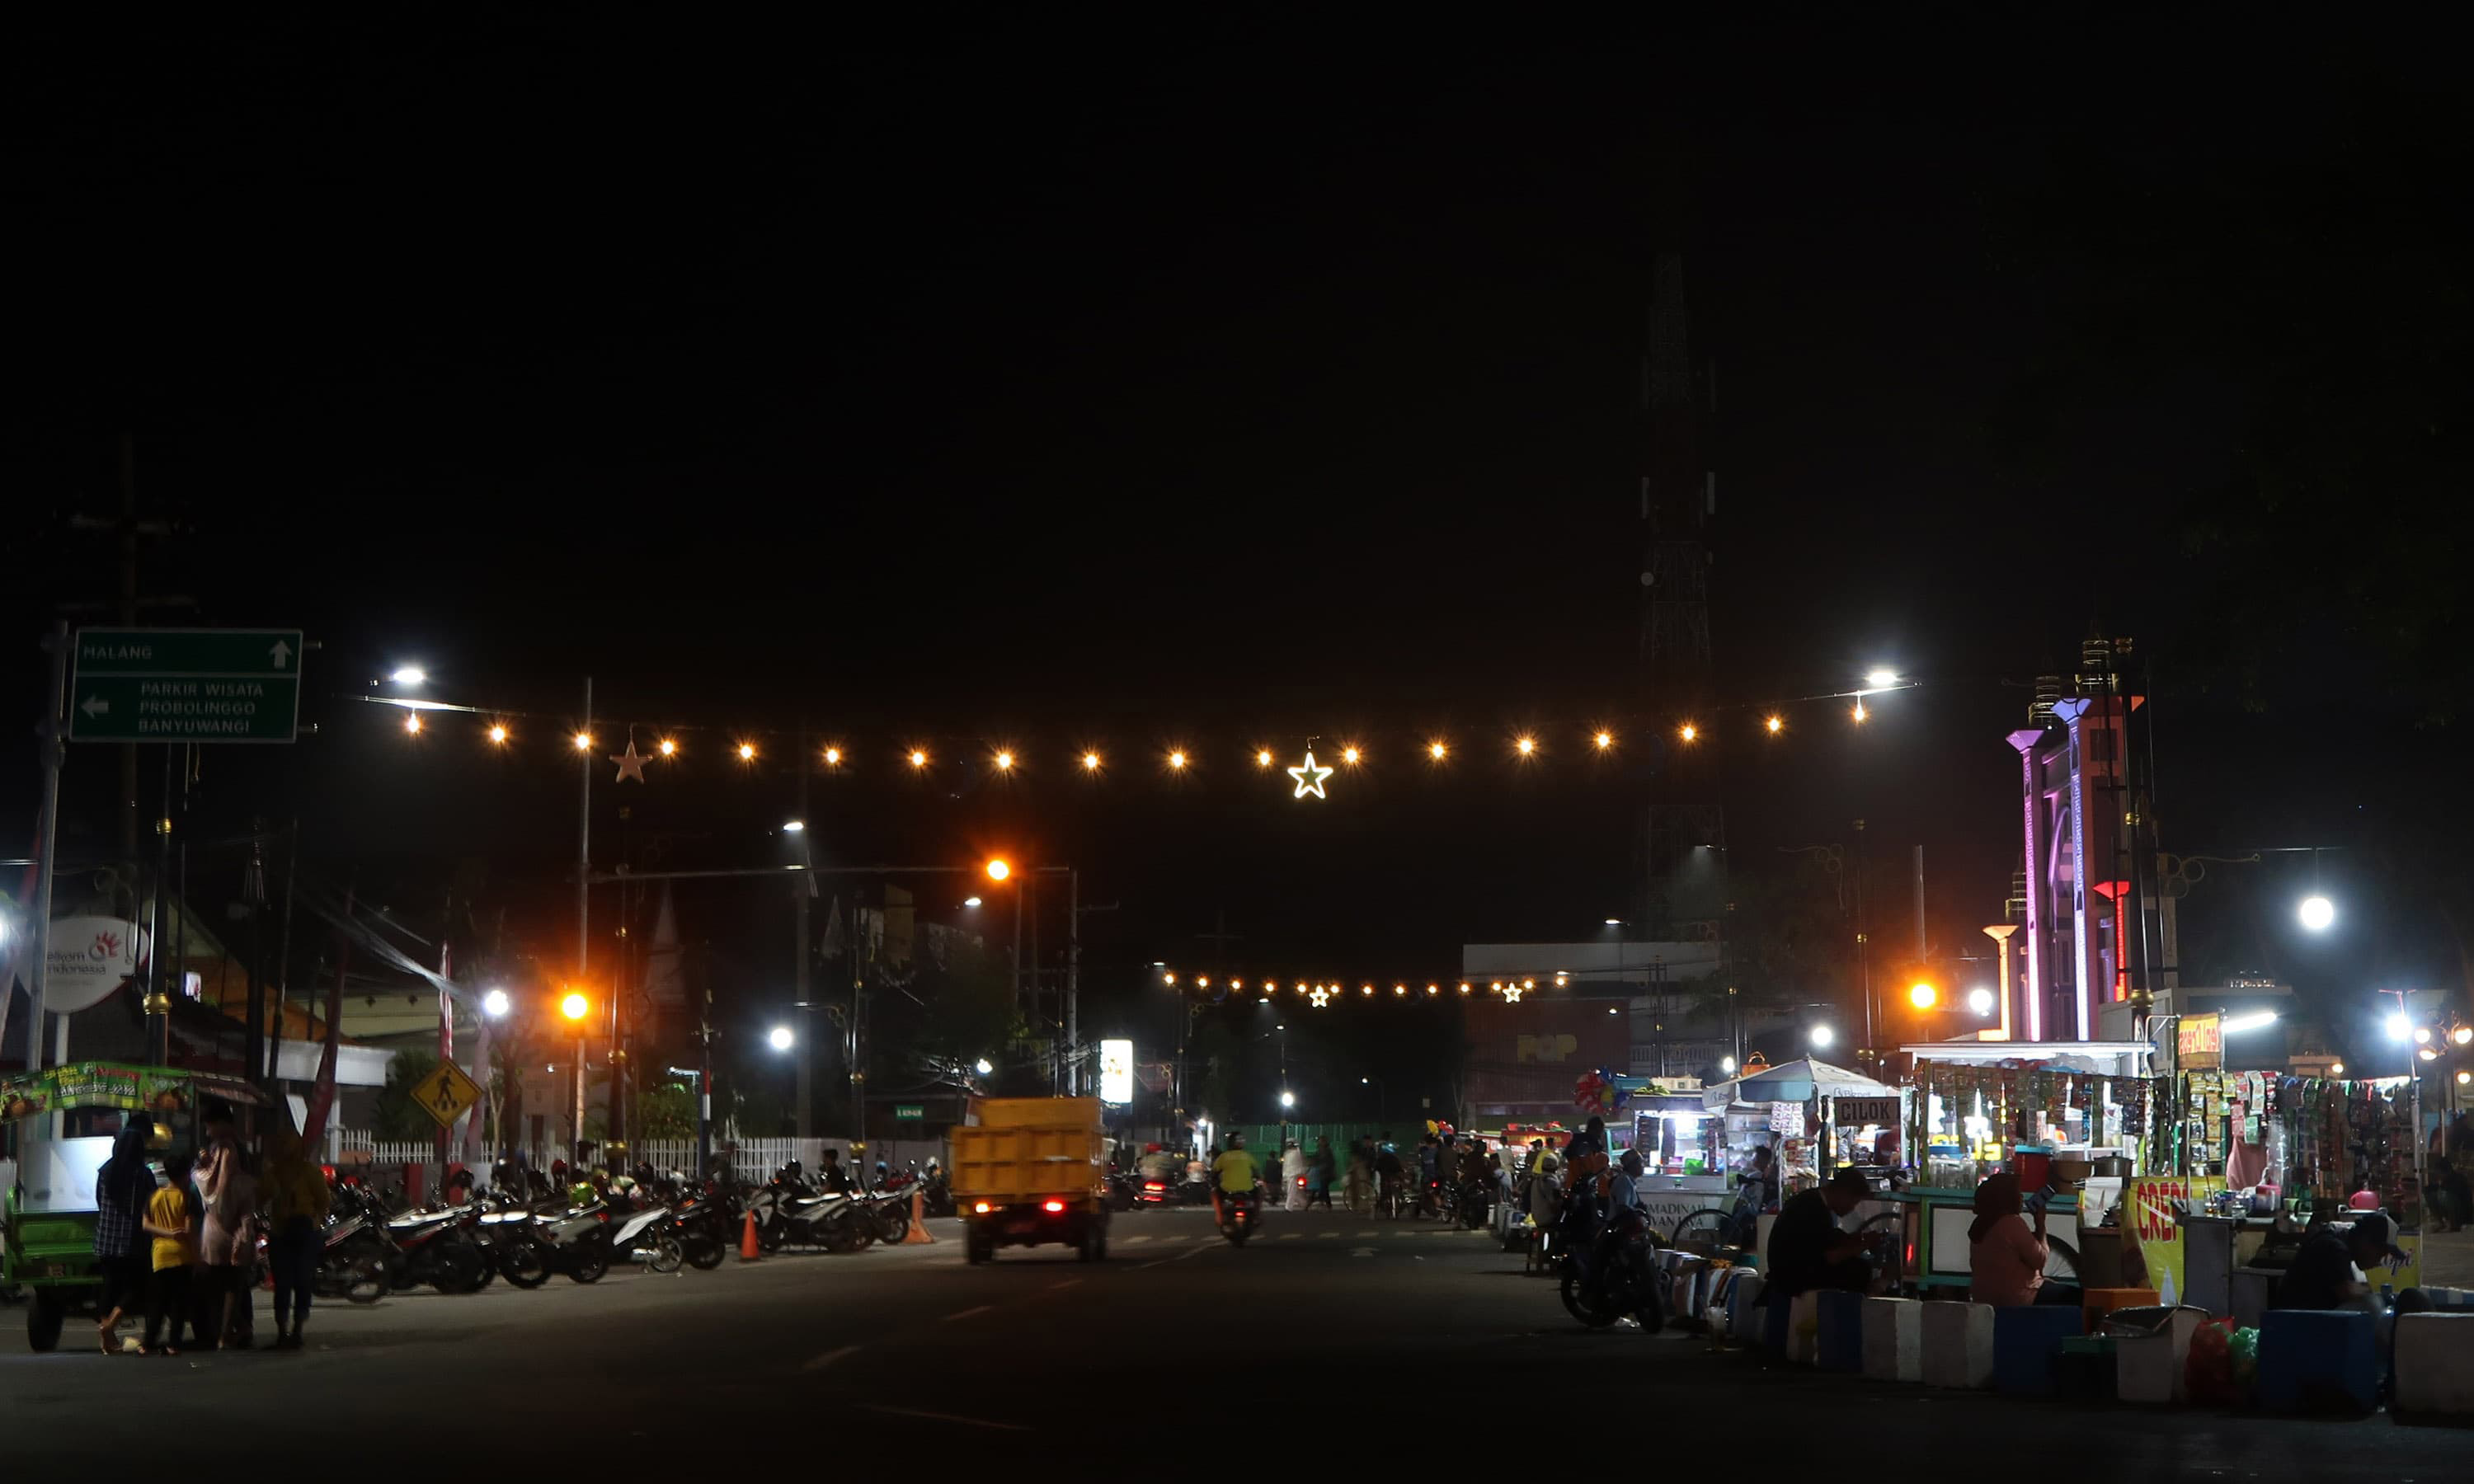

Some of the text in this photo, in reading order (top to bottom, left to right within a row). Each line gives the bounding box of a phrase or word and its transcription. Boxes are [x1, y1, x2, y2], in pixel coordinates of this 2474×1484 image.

[83, 646, 153, 660] MALANG
[142, 683, 264, 697] PARKIR WISATA
[139, 701, 256, 715] PROBOLINGGO
[139, 719, 249, 733] BANYUWANGI
[47, 950, 85, 963] elkom
[47, 963, 106, 975] ndonesia
[1841, 1101, 1889, 1121] CILOK
